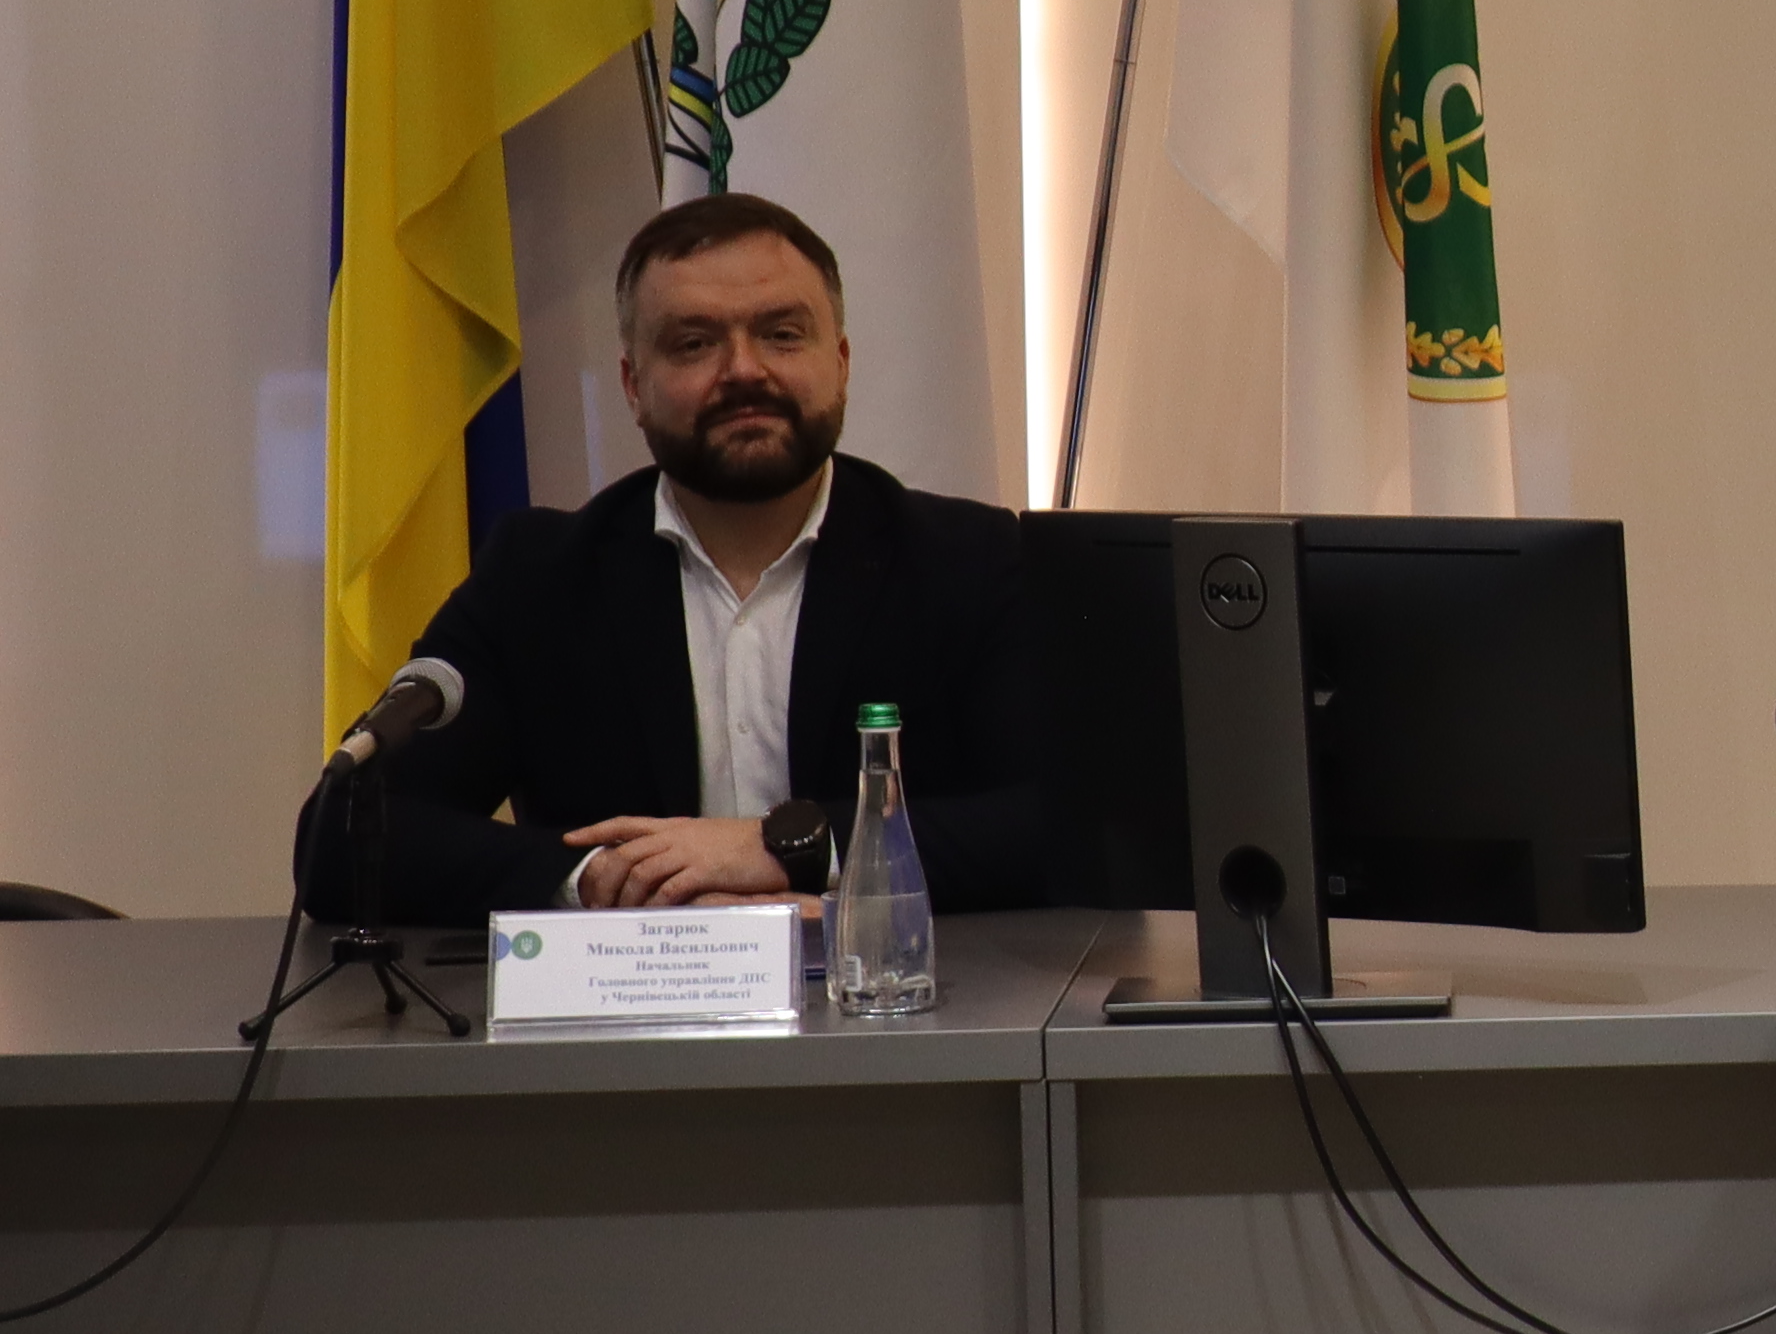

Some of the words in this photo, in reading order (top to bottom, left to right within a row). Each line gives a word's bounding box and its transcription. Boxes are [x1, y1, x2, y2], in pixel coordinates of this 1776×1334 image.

[1207, 582, 1259, 601] DELL
[638, 922, 710, 938] Загарюк
[586, 942, 655, 956] Микола
[659, 940, 760, 955] Васильович
[588, 976, 658, 988] Головного
[660, 973, 736, 989] управління
[738, 971, 772, 985] ДПС
[600, 994, 609, 1005] у
[611, 989, 701, 1004] Чернівецькій
[703, 987, 752, 1000] області
